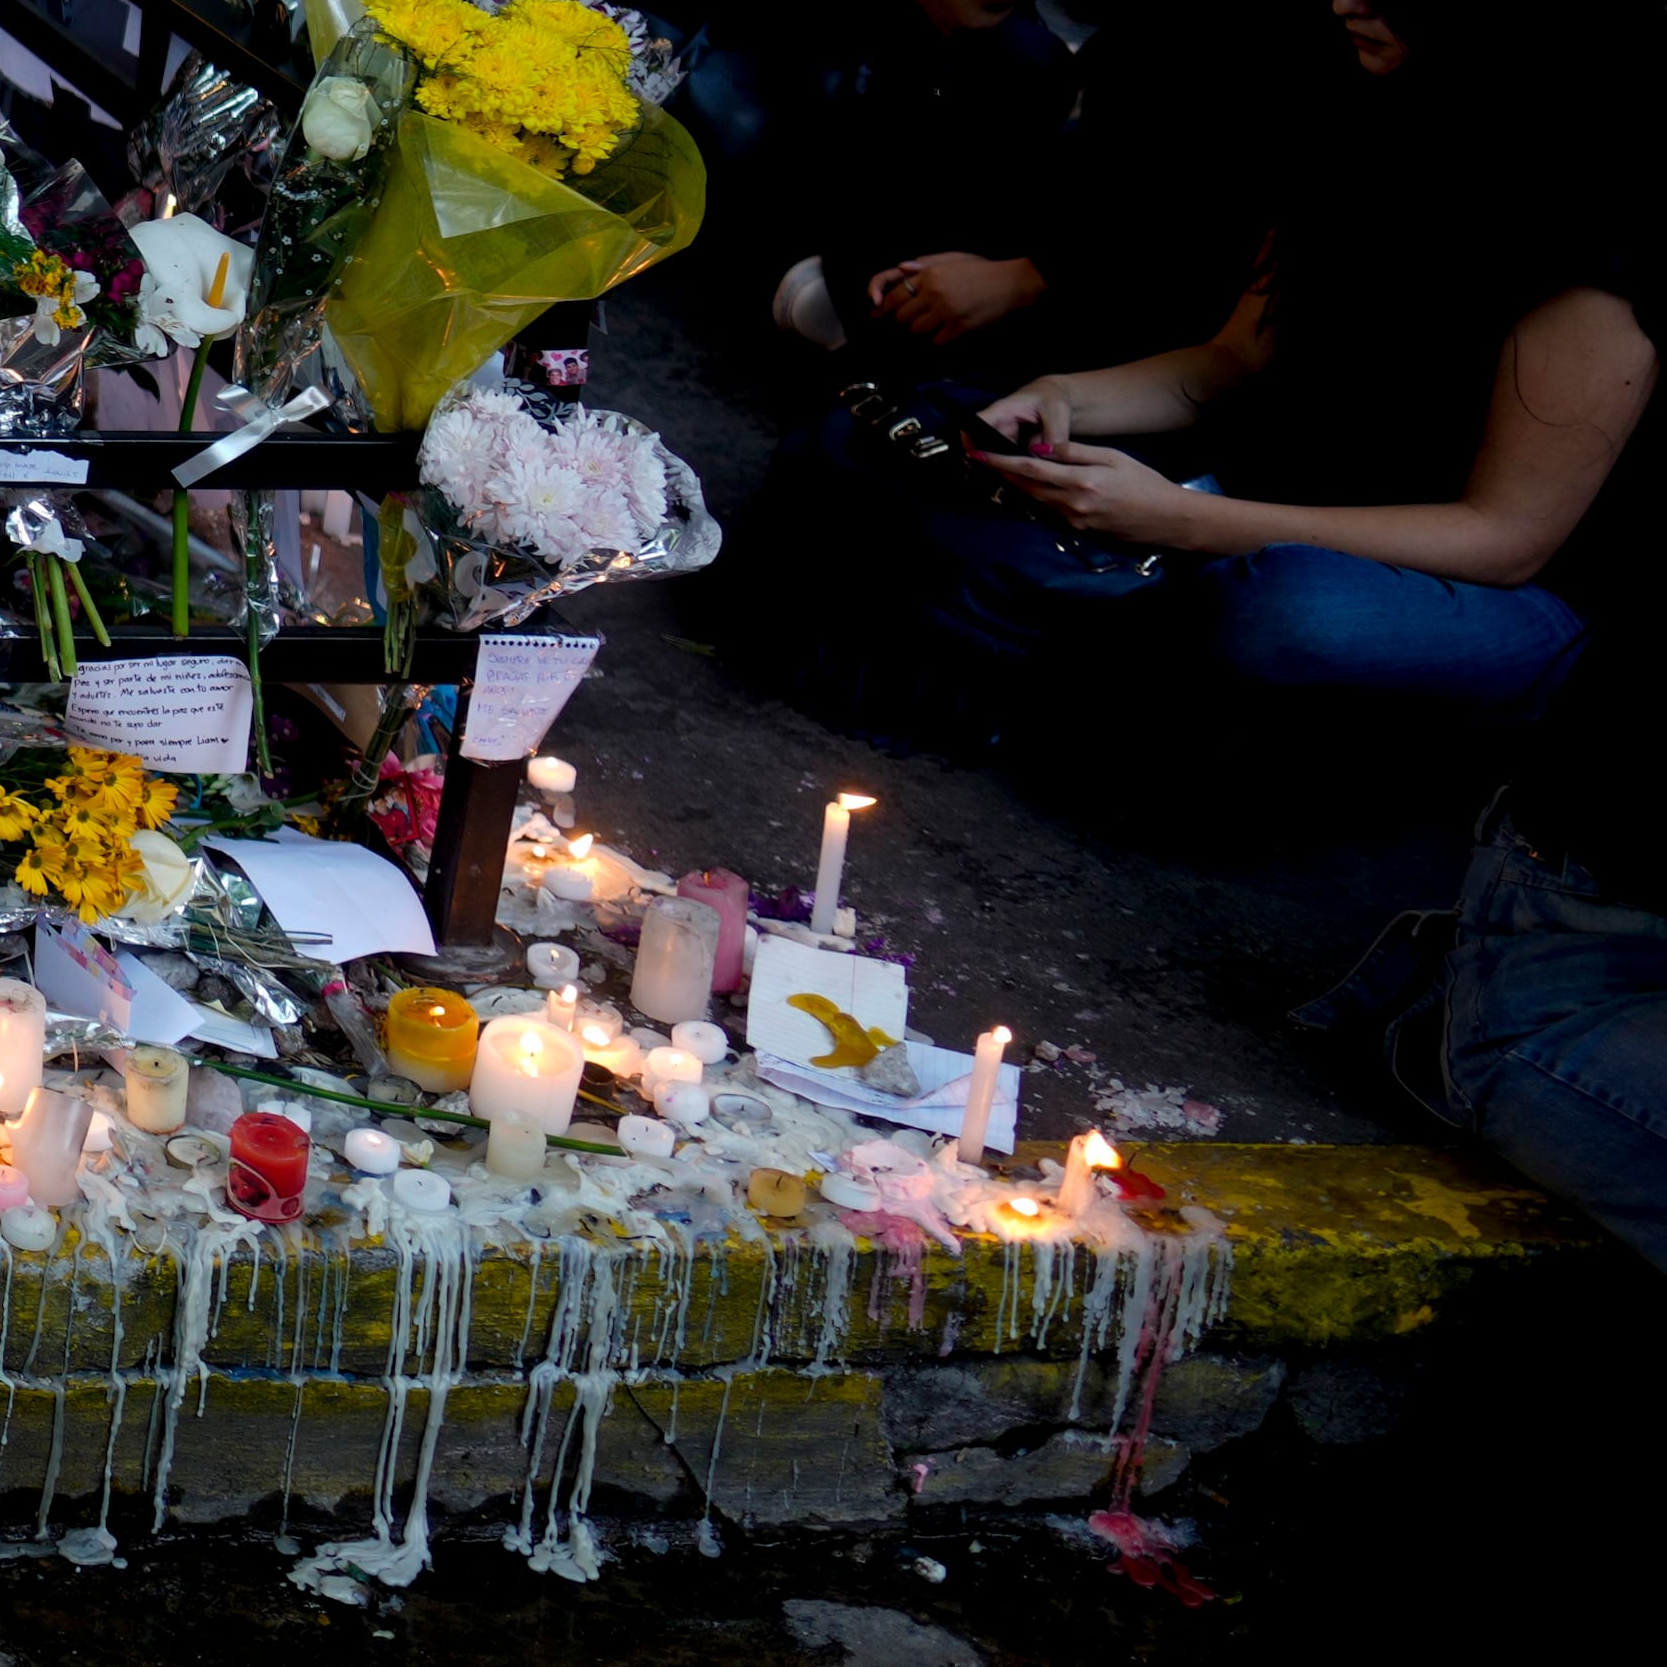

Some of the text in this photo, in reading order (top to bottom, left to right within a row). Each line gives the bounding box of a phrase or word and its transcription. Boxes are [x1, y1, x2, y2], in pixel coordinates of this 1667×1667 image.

[156, 658, 176, 671] lugar
[120, 688, 133, 697] Me
[147, 719, 162, 728] dar
[197, 736, 219, 745] Liam
[153, 754, 177, 762] vida
